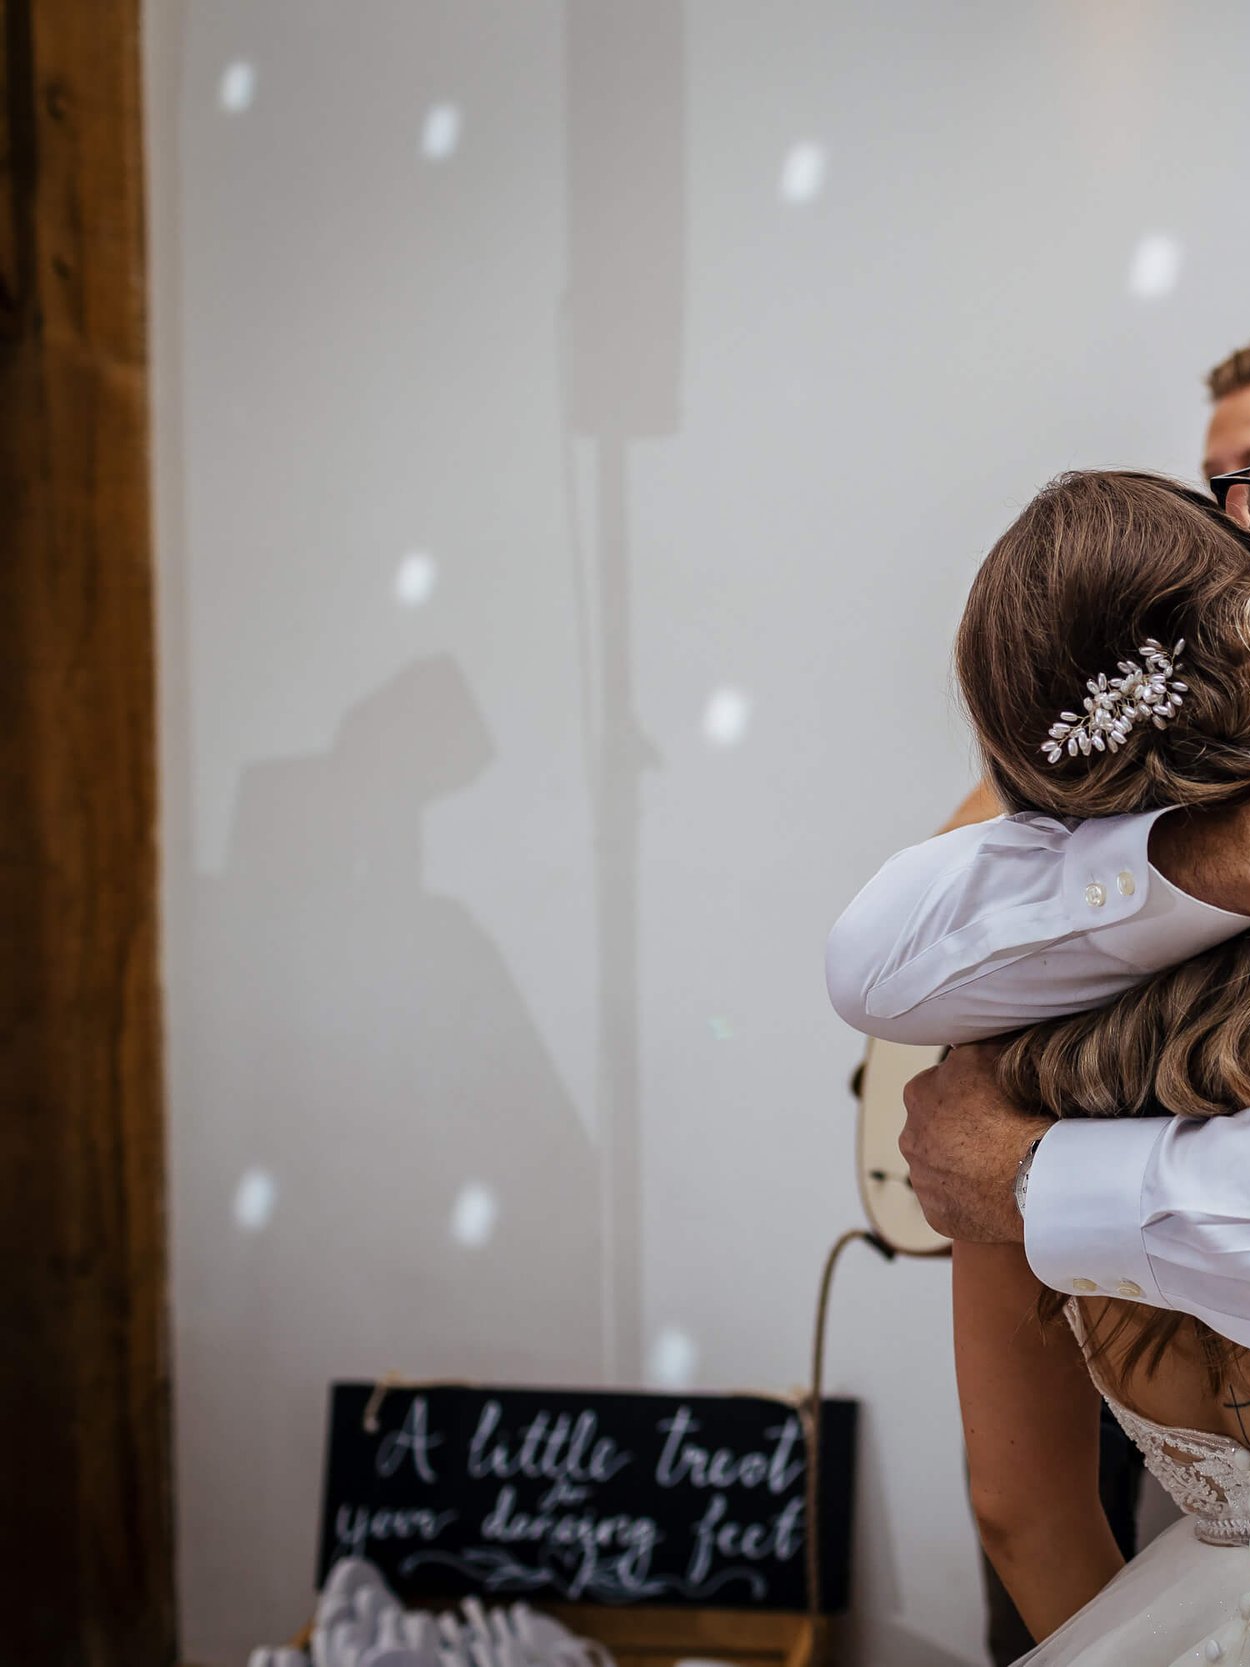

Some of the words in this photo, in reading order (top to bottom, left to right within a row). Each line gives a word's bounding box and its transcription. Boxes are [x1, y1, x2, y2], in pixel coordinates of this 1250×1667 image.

[376, 1396, 444, 1484] A
[468, 1400, 632, 1482] little
[656, 1404, 806, 1494] treat
[335, 1504, 458, 1557] your
[689, 1494, 806, 1582] feet
